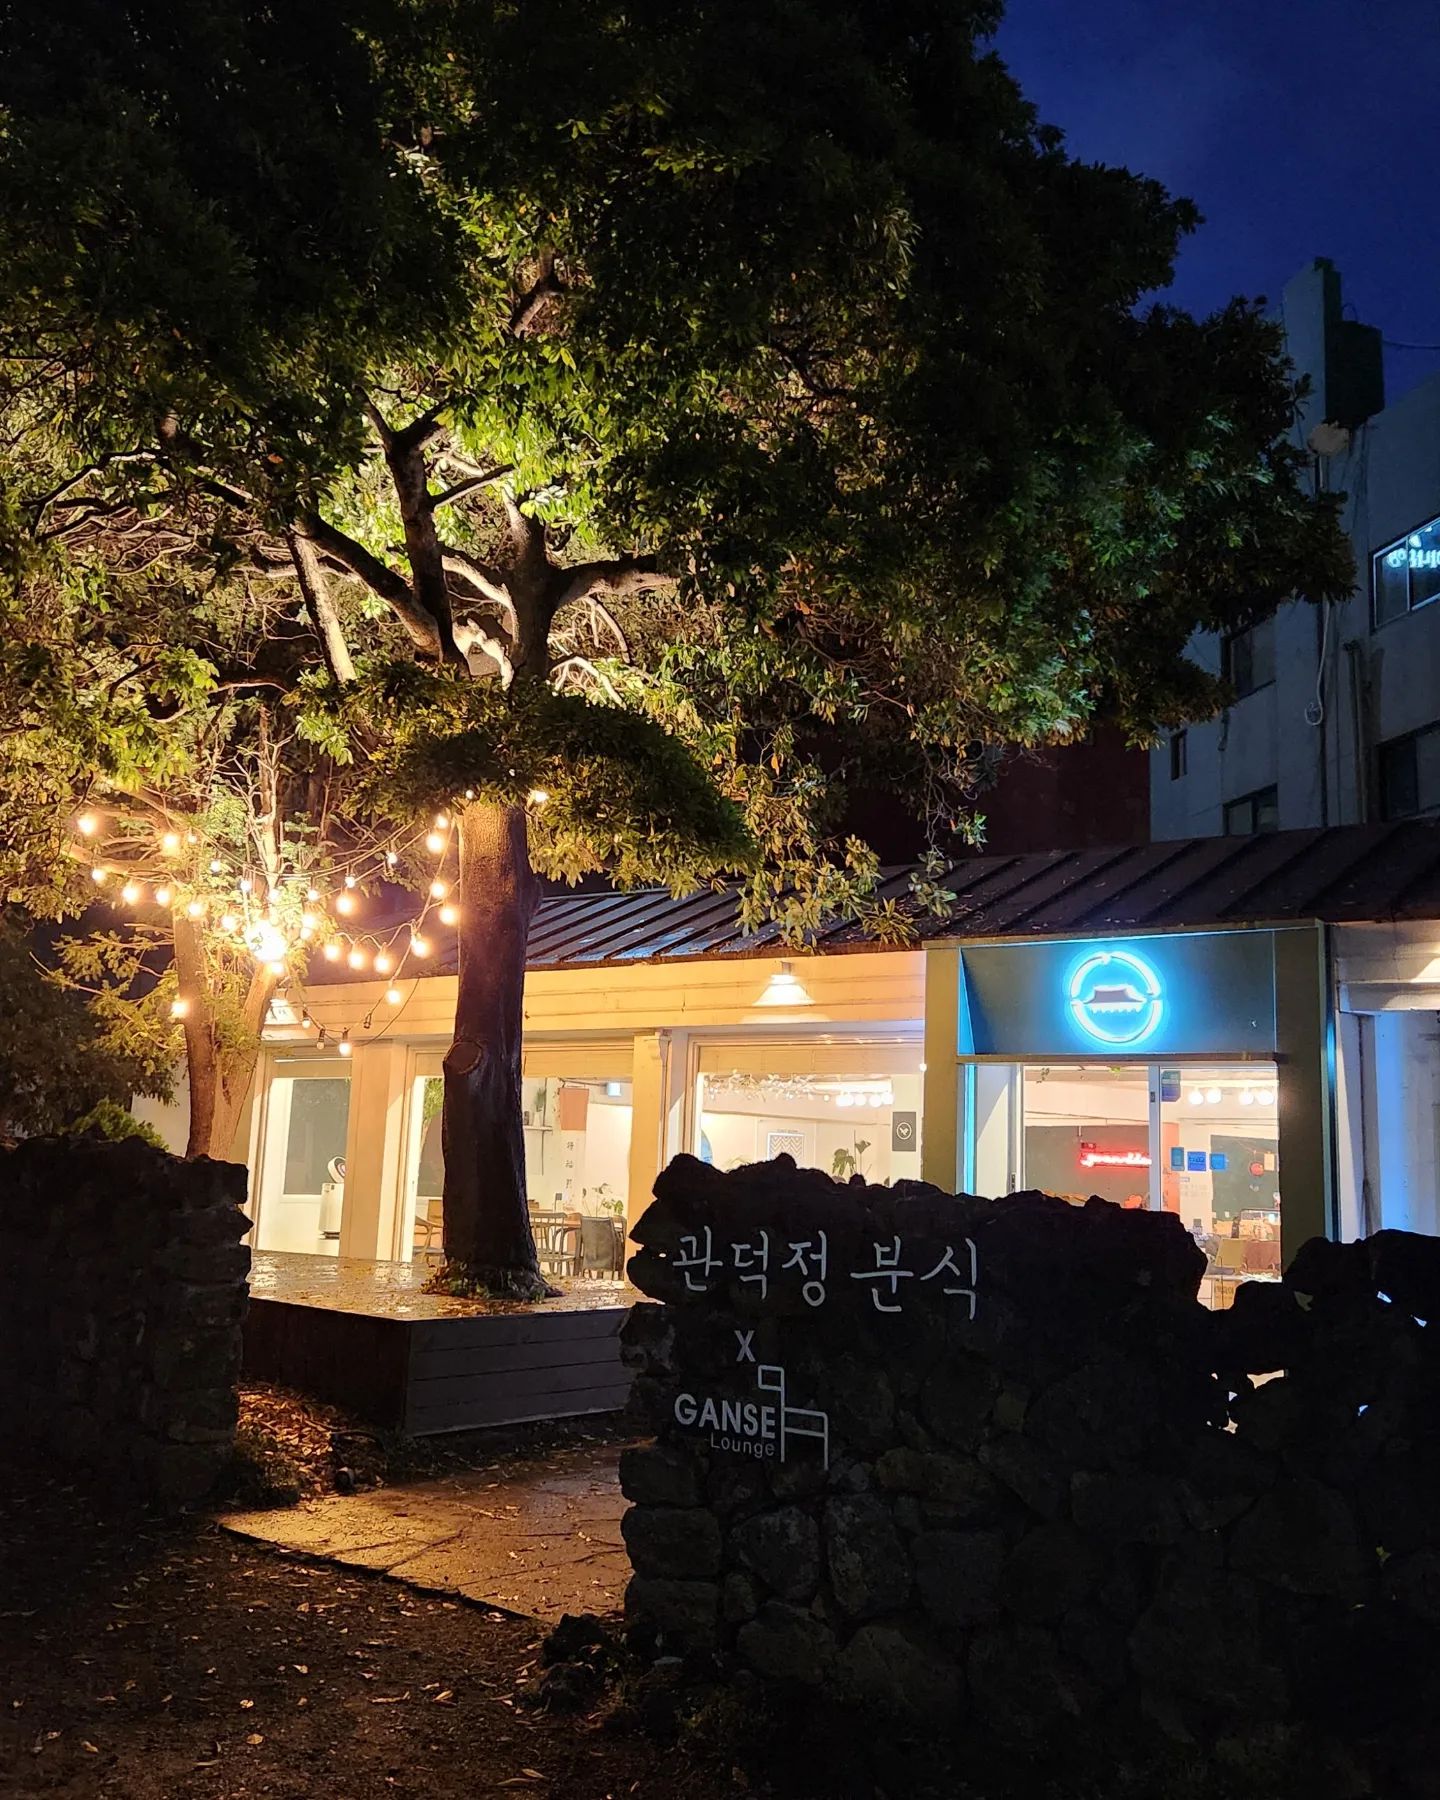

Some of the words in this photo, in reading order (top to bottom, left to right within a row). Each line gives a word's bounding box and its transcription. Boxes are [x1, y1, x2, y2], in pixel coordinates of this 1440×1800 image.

[673, 1225, 827, 1307] 관덕정
[849, 1235, 978, 1320] 분식
[734, 1329, 756, 1362] X
[673, 1393, 776, 1439] GANSE
[709, 1431, 776, 1458] Lounge
